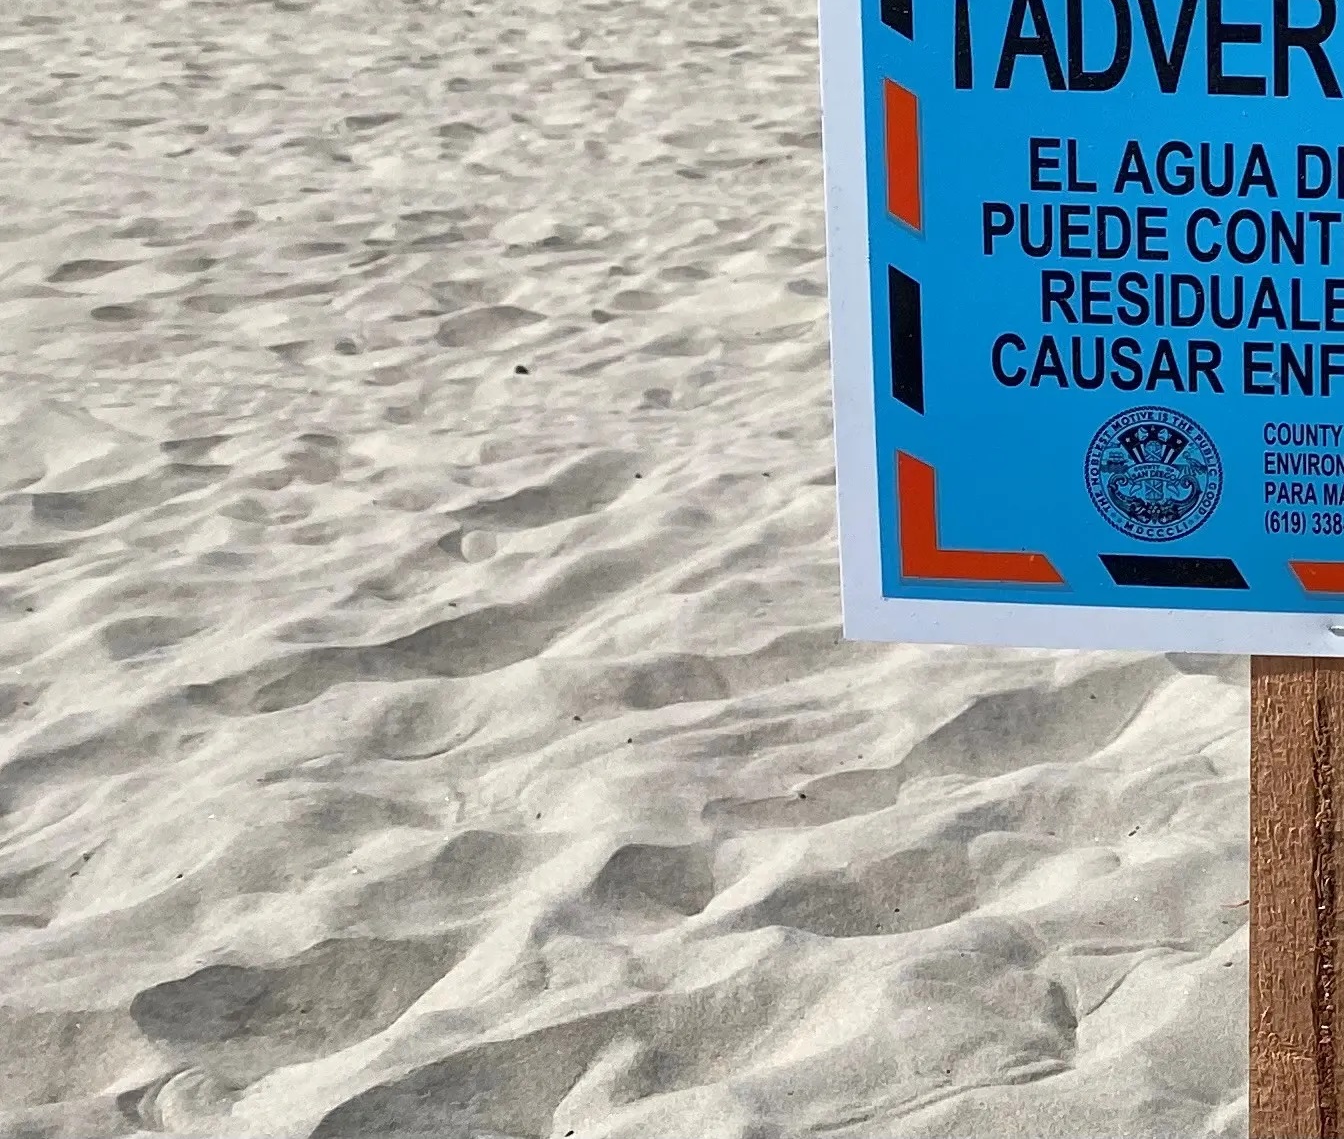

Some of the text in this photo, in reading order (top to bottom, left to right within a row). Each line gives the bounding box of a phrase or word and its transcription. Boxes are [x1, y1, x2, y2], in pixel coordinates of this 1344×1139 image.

[1029, 137, 1098, 193] EL
[1113, 140, 1278, 198] AGUA
[982, 202, 1169, 261] PUEDE
[991, 333, 1225, 394] CAUSAR
[1089, 410, 1219, 517] THE NOBLEST MOTIVE IS THE PUBLIC GOOD
[1263, 422, 1344, 447] COUNTY
[1264, 481, 1318, 506] PARA
[1264, 509, 1307, 535] (619)
